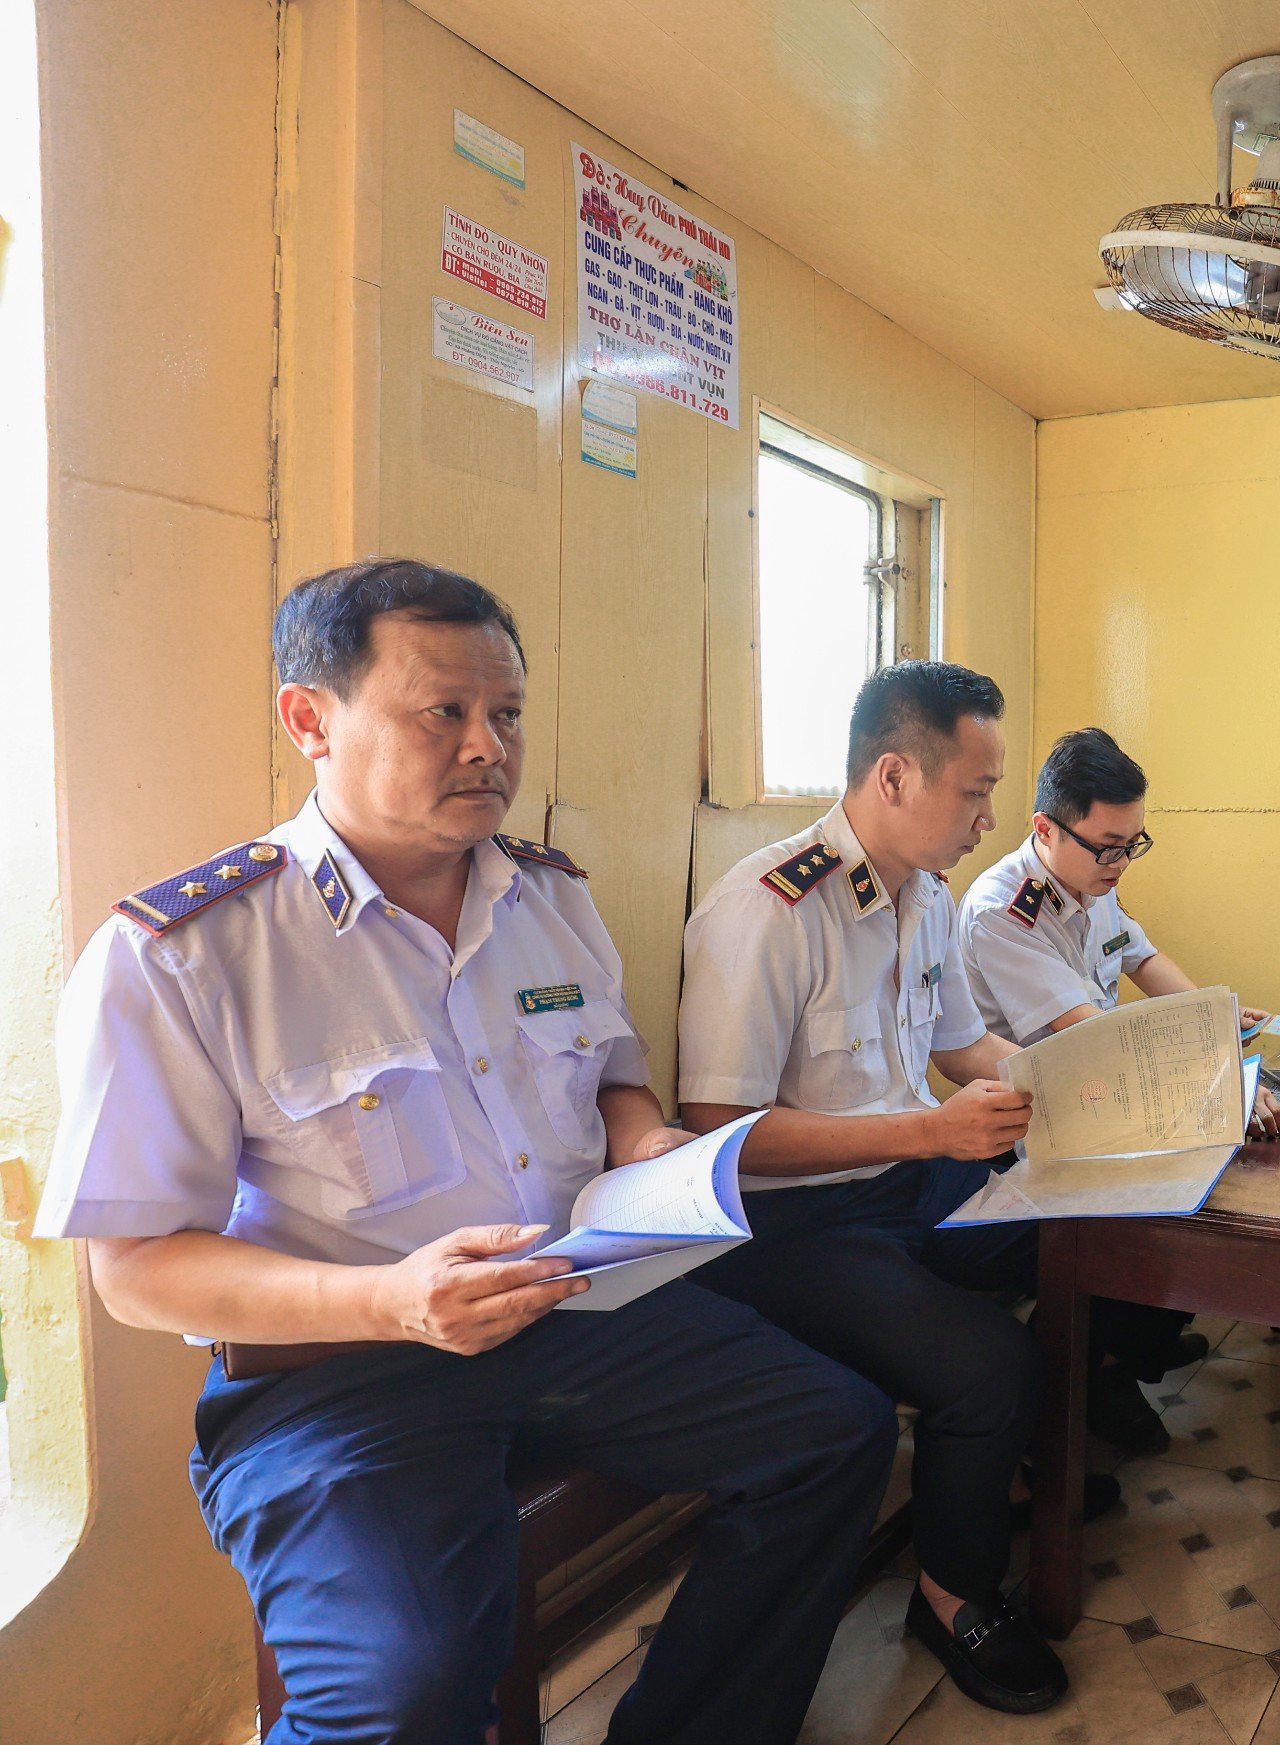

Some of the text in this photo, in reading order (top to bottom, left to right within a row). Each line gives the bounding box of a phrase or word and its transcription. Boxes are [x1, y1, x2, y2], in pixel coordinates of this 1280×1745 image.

[613, 172, 645, 213] Huy
[647, 195, 677, 228] Văn
[497, 241, 518, 258] QUY
[618, 208, 695, 279] Chuyên
[508, 273, 520, 285] BIA
[585, 231, 732, 325] CUNG CẤP THỰC PHẨM HÀNG KHÔ
[585, 258, 599, 278] GAS
[607, 270, 621, 290] GẠO
[629, 280, 643, 302] THỊT
[645, 289, 658, 308] LỢN
[665, 299, 681, 320] TRÂU
[506, 330, 528, 346] Sen
[588, 282, 608, 304] NGAN
[615, 295, 624, 312] GÀ
[631, 303, 641, 322] VỊT
[647, 311, 665, 332] RƯỢU
[671, 323, 681, 340] BIA
[688, 331, 704, 351] NƯỚC
[588, 305, 621, 333] THỢ
[625, 323, 655, 345] LẶN
[660, 339, 699, 368] CHÂN
[703, 360, 725, 380] VỊT
[698, 377, 724, 399] VỤN
